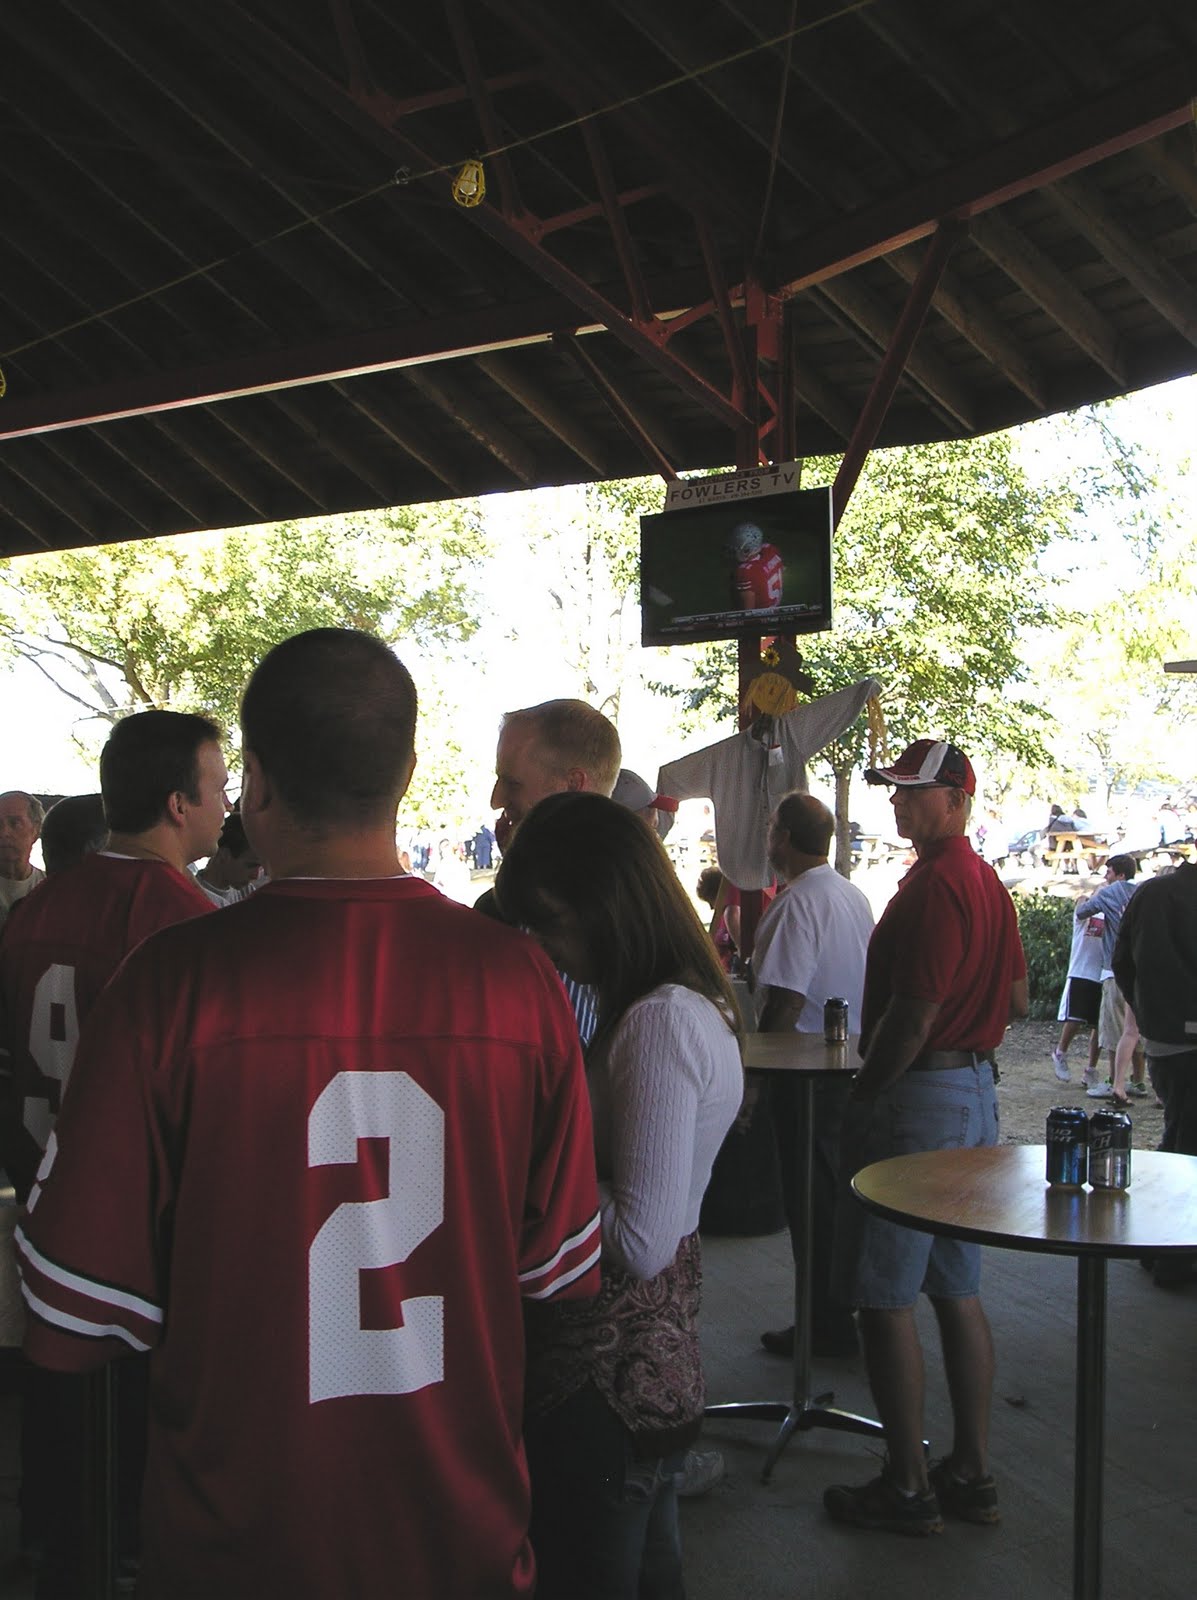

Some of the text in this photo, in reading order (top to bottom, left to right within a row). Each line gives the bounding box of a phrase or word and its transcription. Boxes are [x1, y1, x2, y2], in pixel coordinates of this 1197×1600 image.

[671, 478, 761, 502] FOWLERS
[771, 472, 795, 486] TV
[308, 1071, 444, 1404] 2
